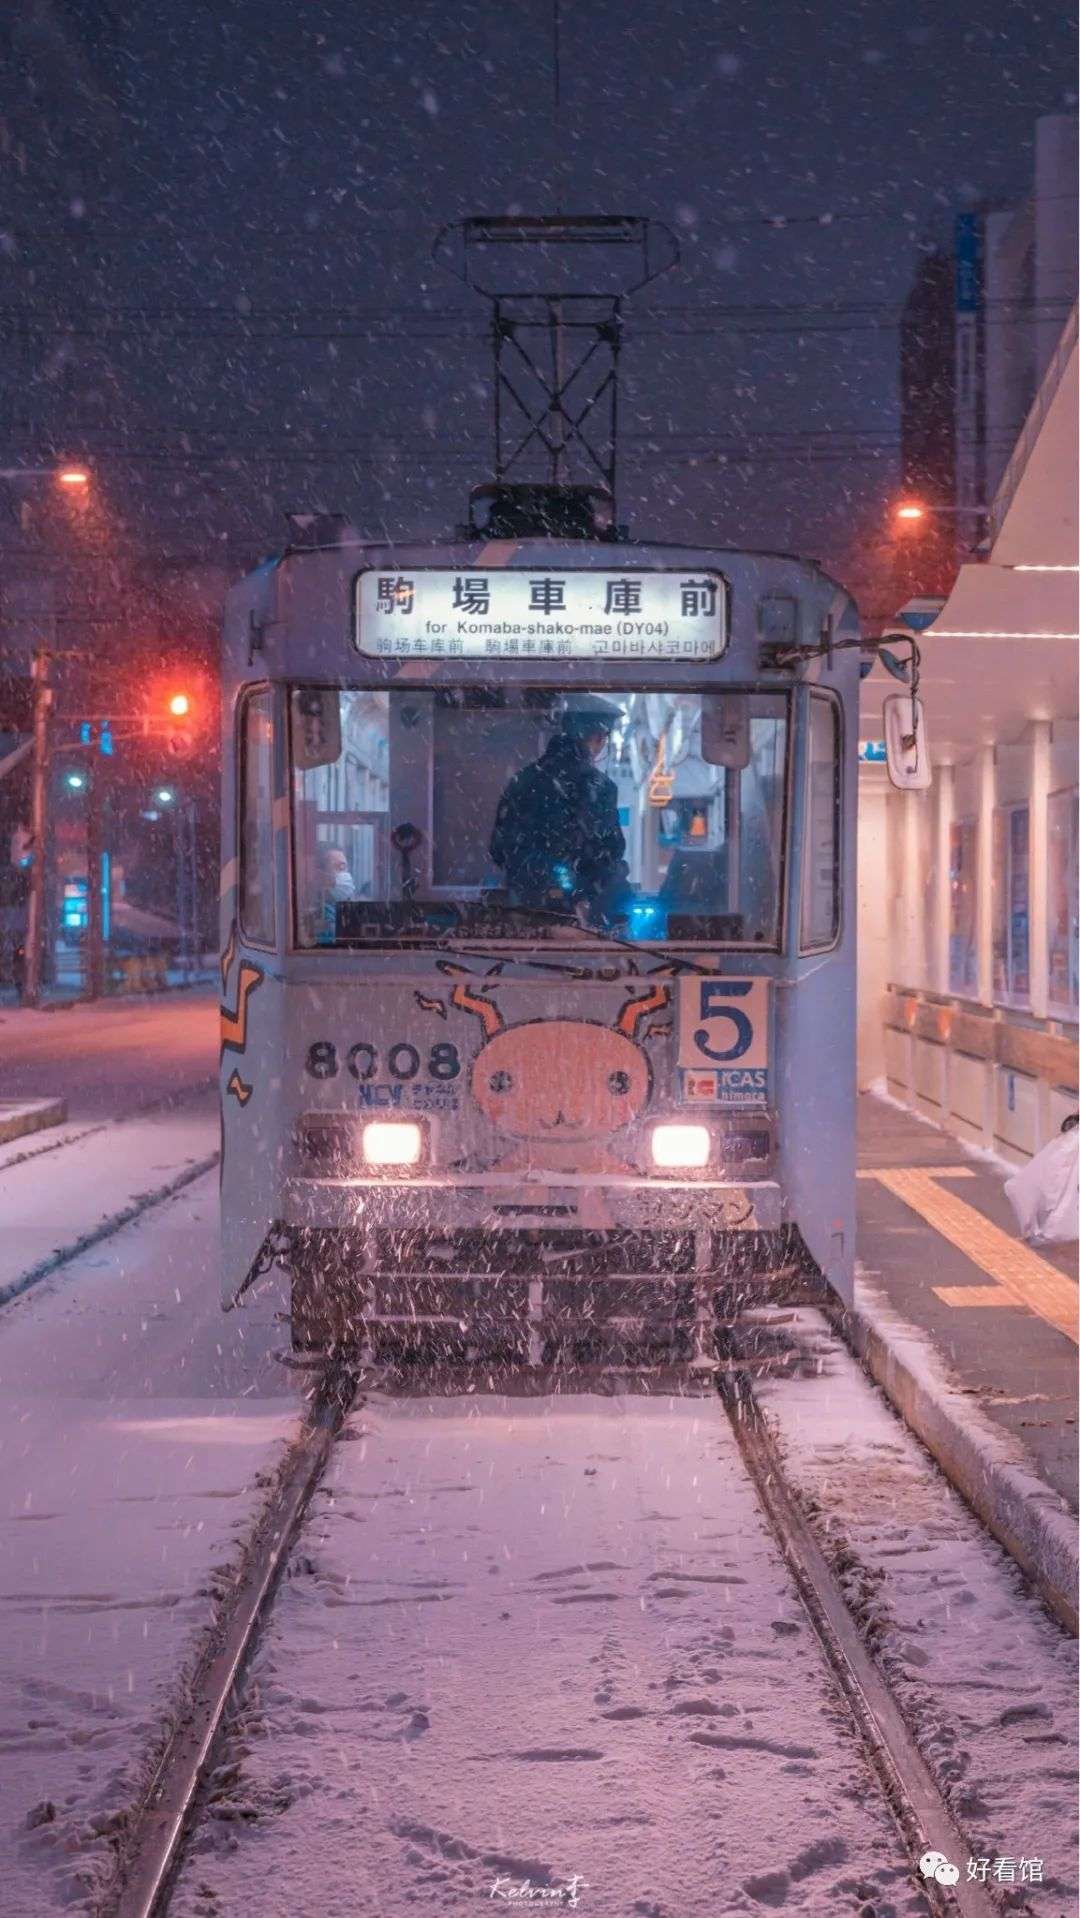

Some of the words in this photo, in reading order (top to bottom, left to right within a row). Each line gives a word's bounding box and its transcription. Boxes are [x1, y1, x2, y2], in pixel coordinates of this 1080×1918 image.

[376, 576, 717, 617] 駒場車庫前
[426, 621, 447, 633] for
[457, 621, 612, 634] Komaba-shako-mae
[616, 622, 669, 636] (DY04)
[694, 981, 753, 1061] 5
[305, 1041, 461, 1080] 8008
